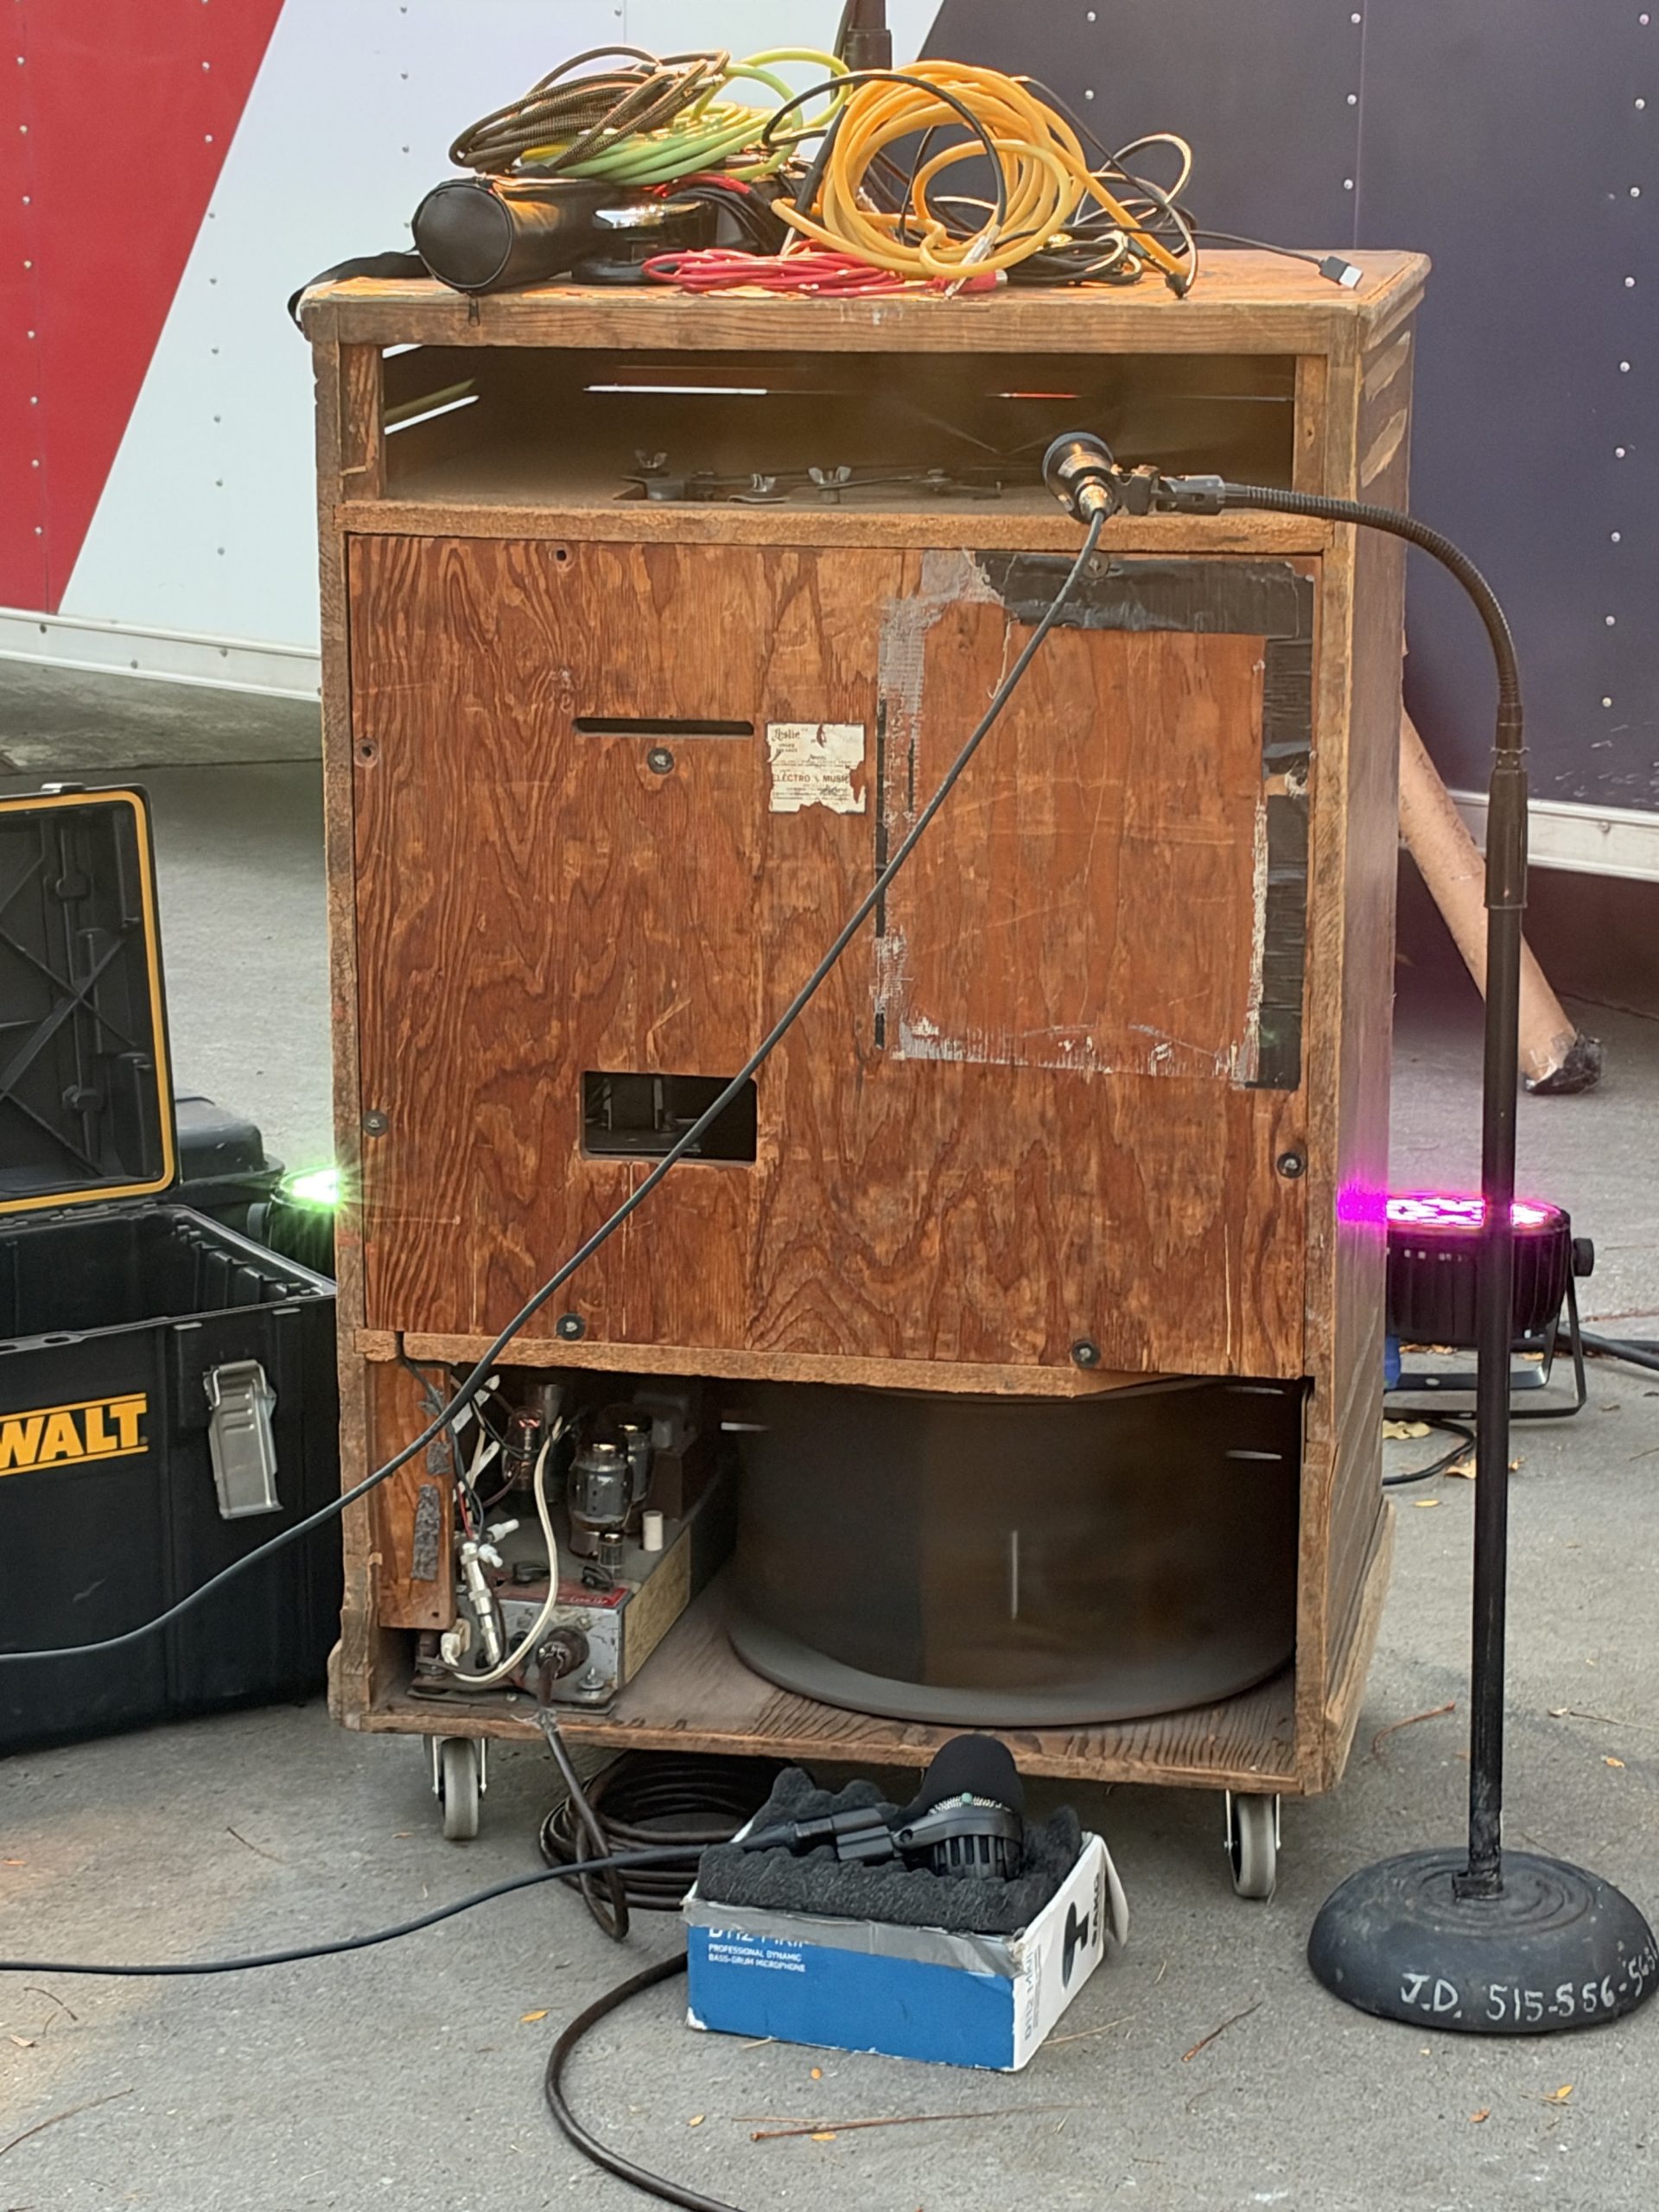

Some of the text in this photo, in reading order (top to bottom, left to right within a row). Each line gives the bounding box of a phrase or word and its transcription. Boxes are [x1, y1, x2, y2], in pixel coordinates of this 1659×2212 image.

[709, 1943, 802, 1962] PROFESSIONAL DYNAMIC
[709, 1953, 805, 1973] BASS-DRUM MICROPHONE
